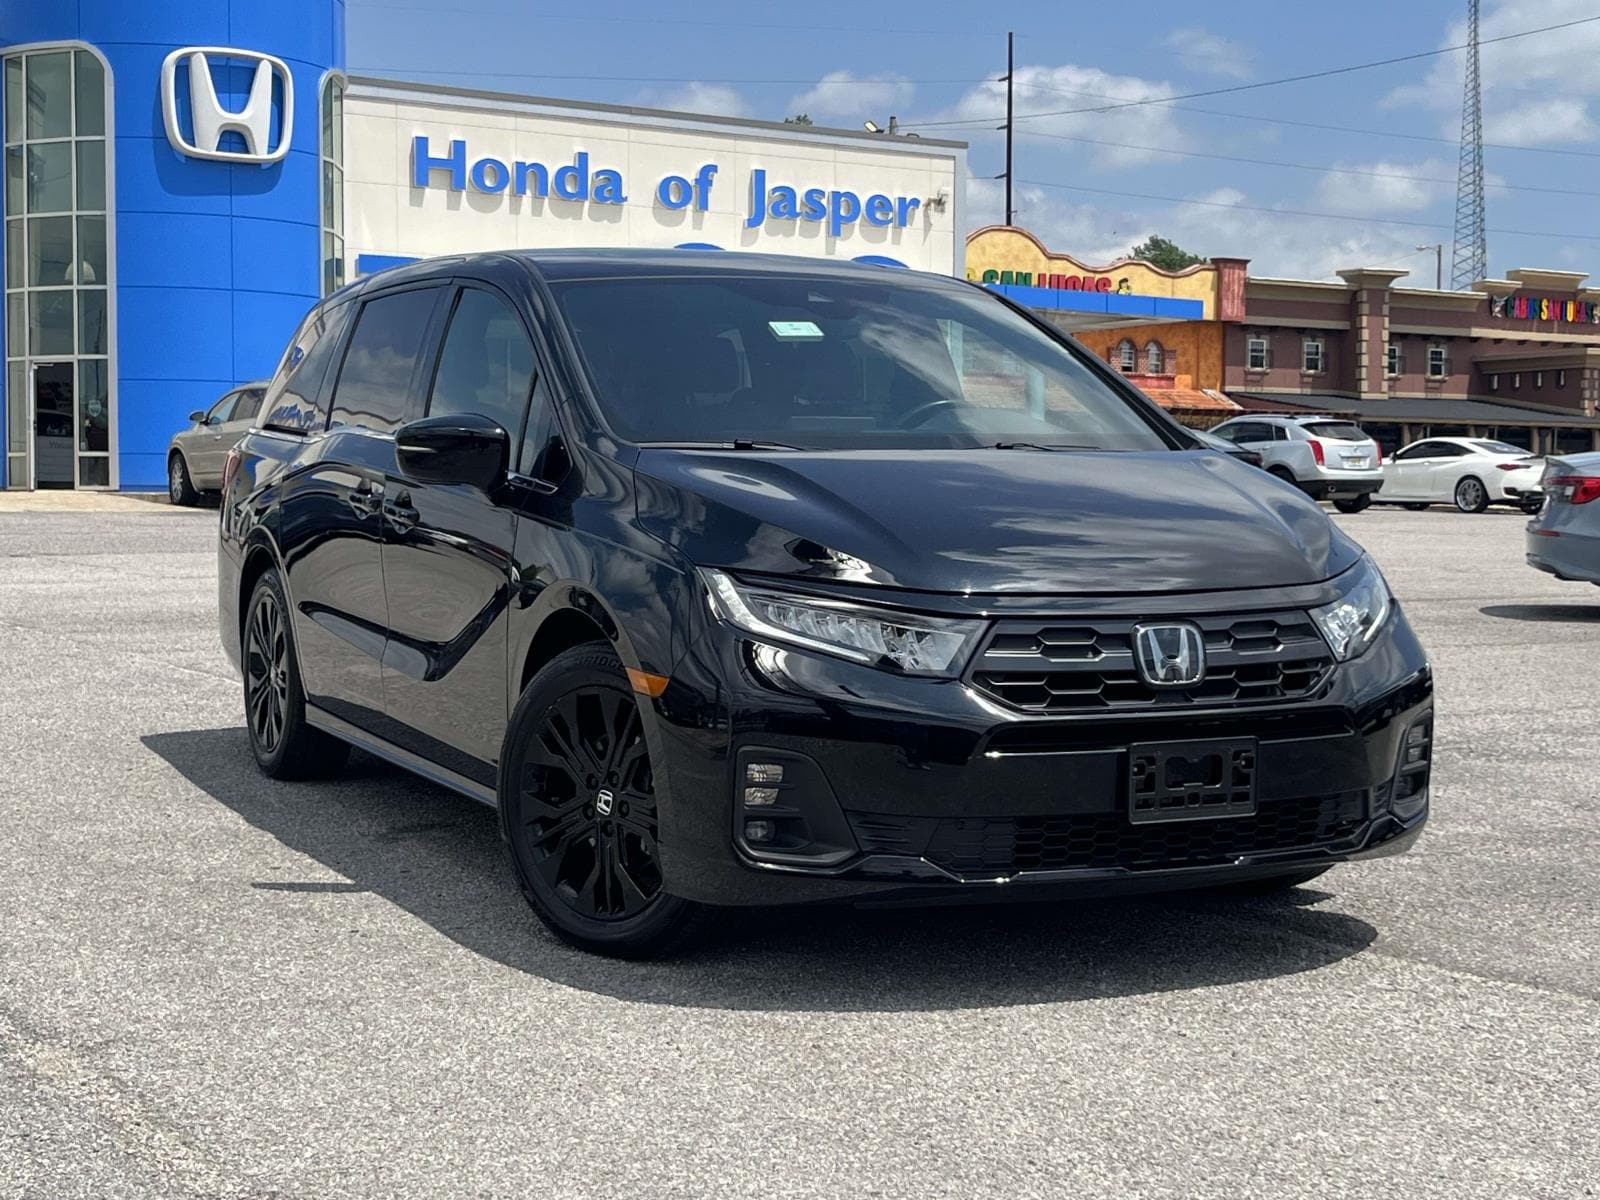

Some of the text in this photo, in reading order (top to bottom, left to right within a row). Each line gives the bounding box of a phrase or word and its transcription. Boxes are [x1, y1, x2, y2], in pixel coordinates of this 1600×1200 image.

[412, 135, 921, 238] Honda of Jasper
